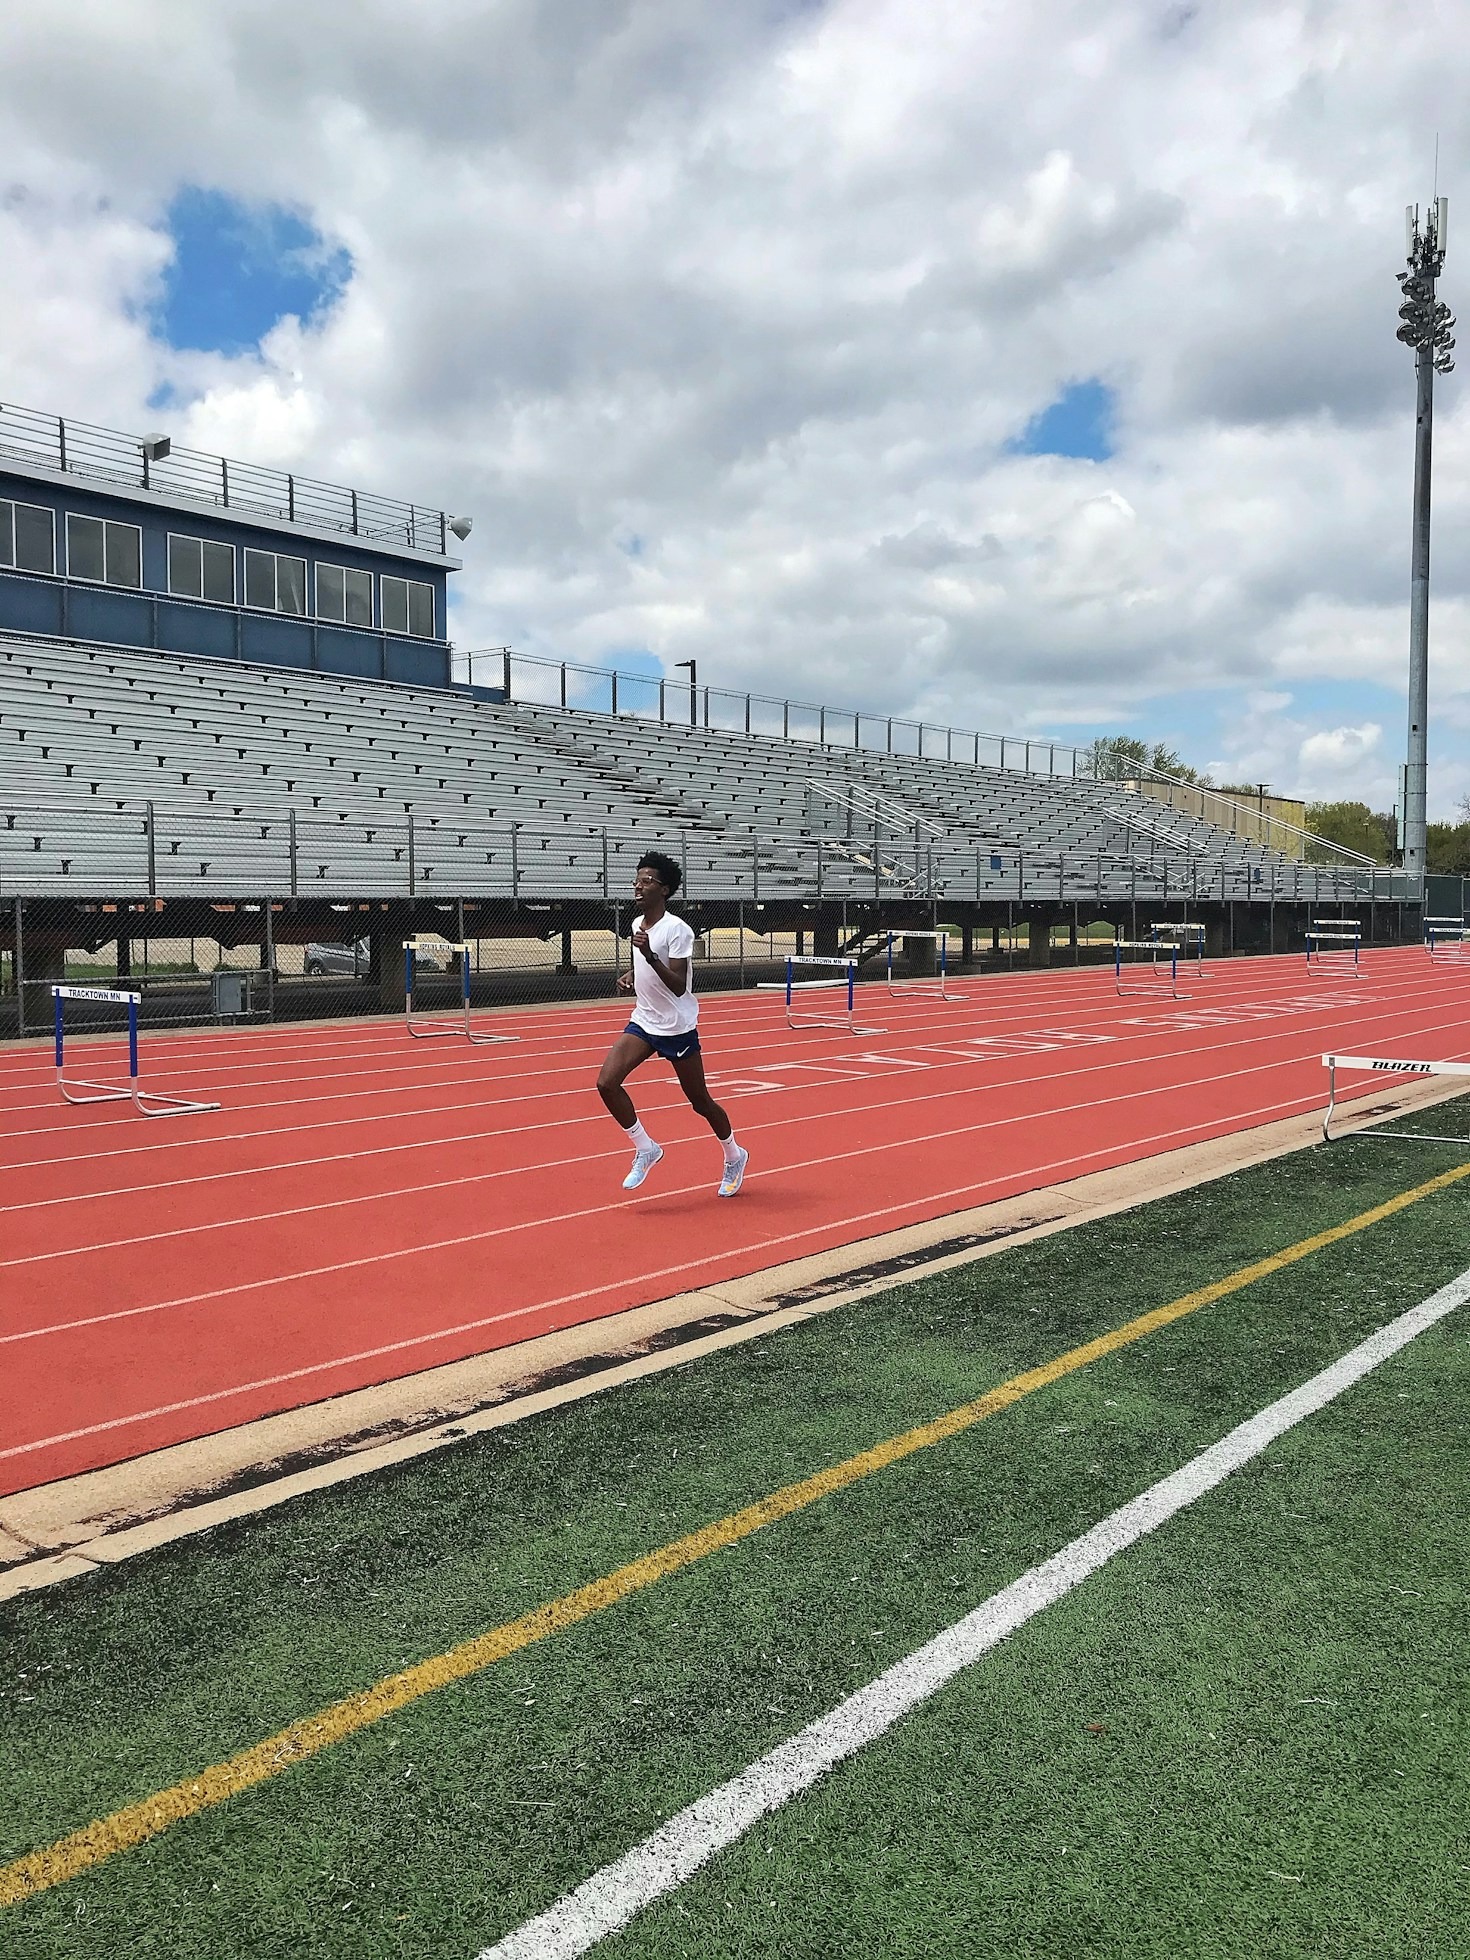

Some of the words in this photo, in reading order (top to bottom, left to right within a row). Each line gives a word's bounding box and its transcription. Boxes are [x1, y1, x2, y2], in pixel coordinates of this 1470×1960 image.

[798, 956, 832, 965] TRACKTOWN
[68, 988, 109, 1000] TRACKTOWN
[110, 992, 121, 1001] MN
[1371, 1061, 1432, 1073] BLAZER
